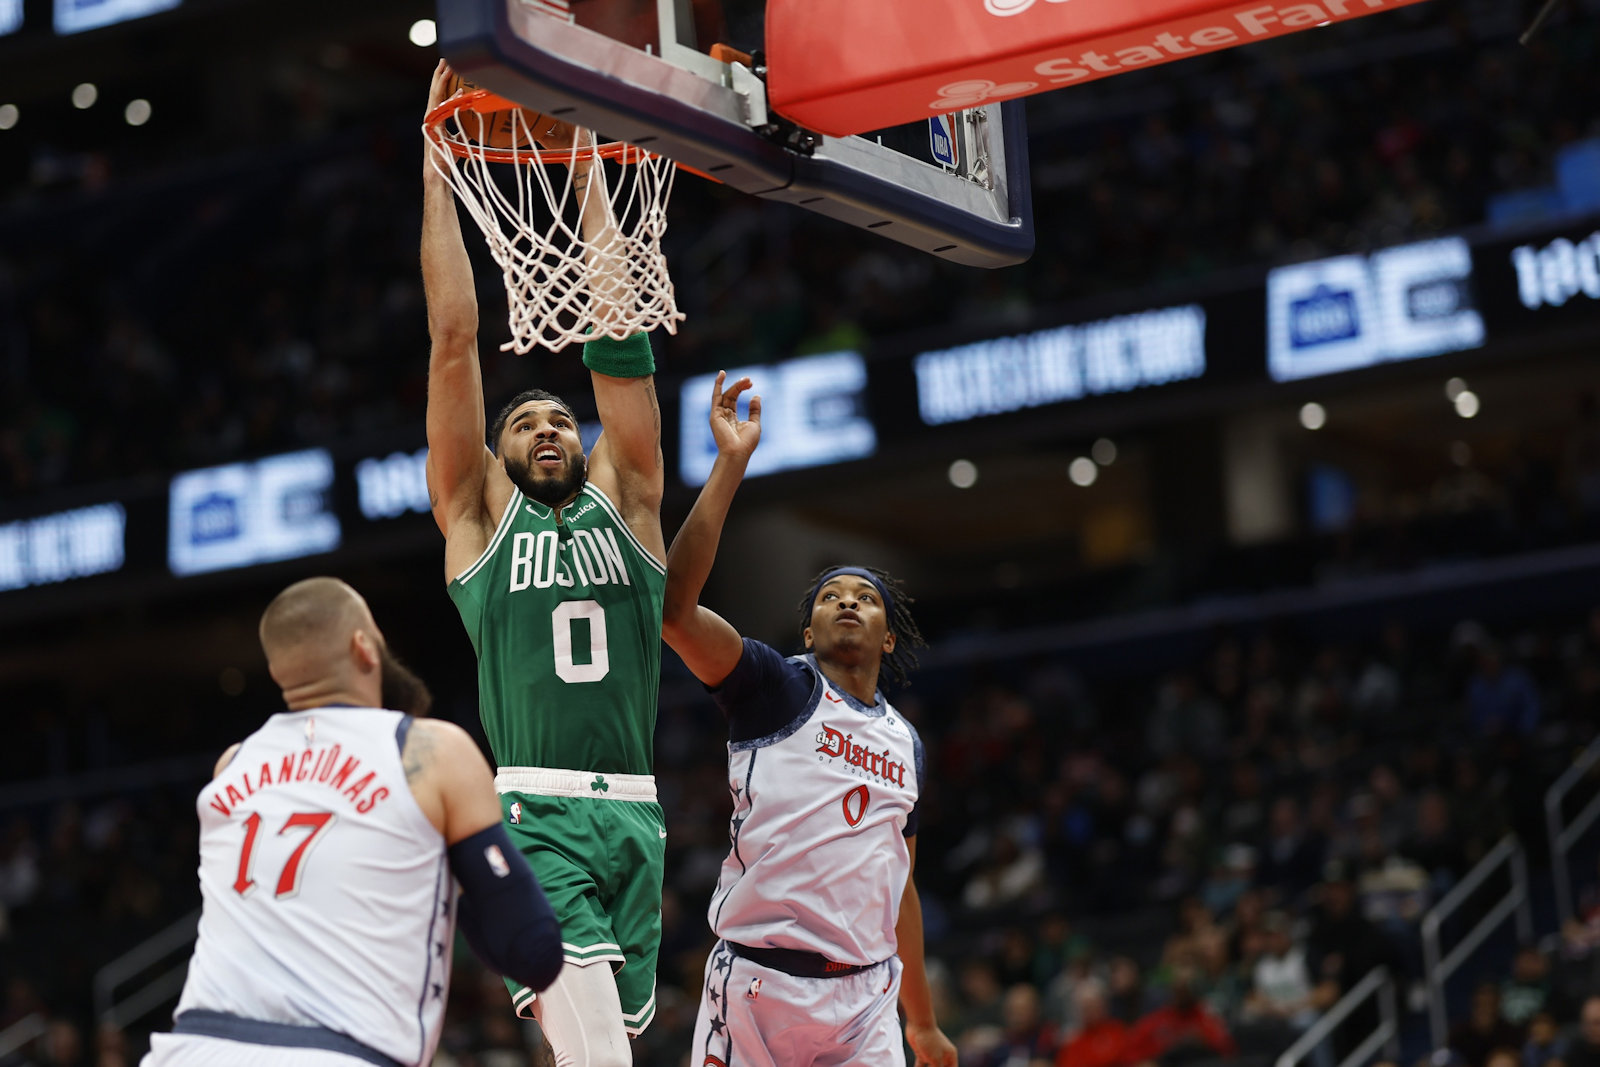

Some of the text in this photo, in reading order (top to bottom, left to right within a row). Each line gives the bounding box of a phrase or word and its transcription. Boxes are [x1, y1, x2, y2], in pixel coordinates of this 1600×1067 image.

[934, 133, 949, 157] NBA
[509, 527, 630, 594] BOSTON
[552, 599, 610, 684] 0
[816, 721, 906, 788] District
[842, 784, 870, 829] 0
[232, 811, 337, 899] 17
